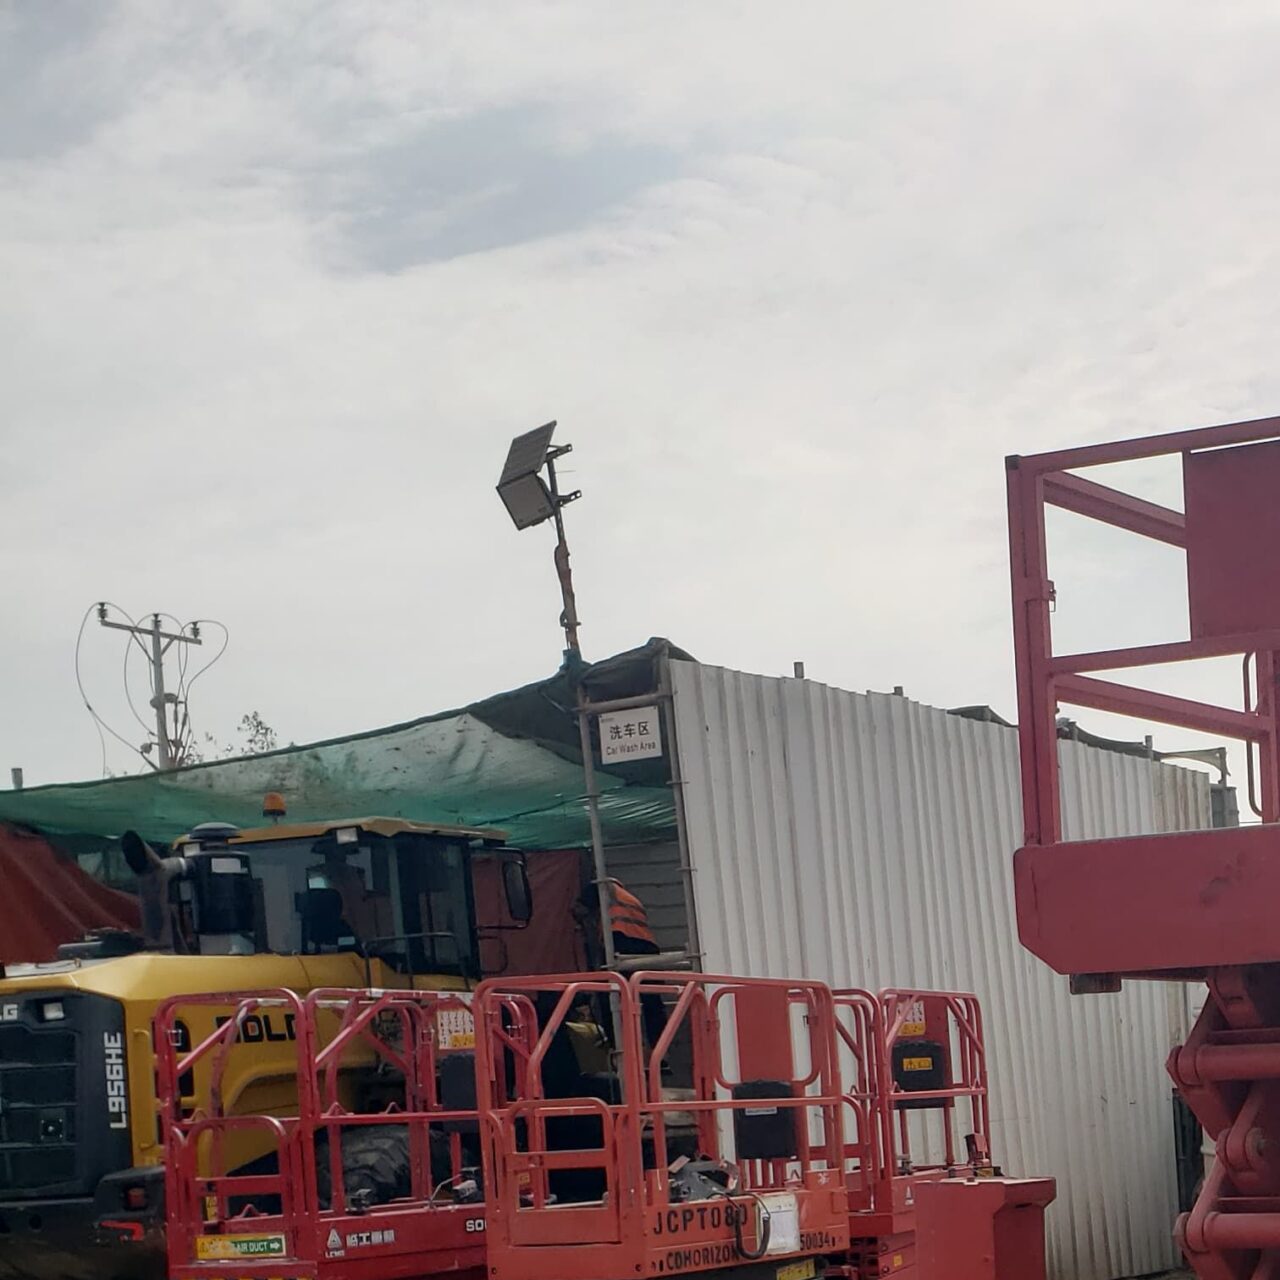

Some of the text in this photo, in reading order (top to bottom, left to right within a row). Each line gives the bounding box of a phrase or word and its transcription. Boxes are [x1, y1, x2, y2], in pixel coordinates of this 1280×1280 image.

[609, 721, 650, 740] 洗车区
[606, 741, 656, 756] Car Wash Area
[104, 1031, 127, 1129] L956HE
[249, 1241, 268, 1252] DUCT
